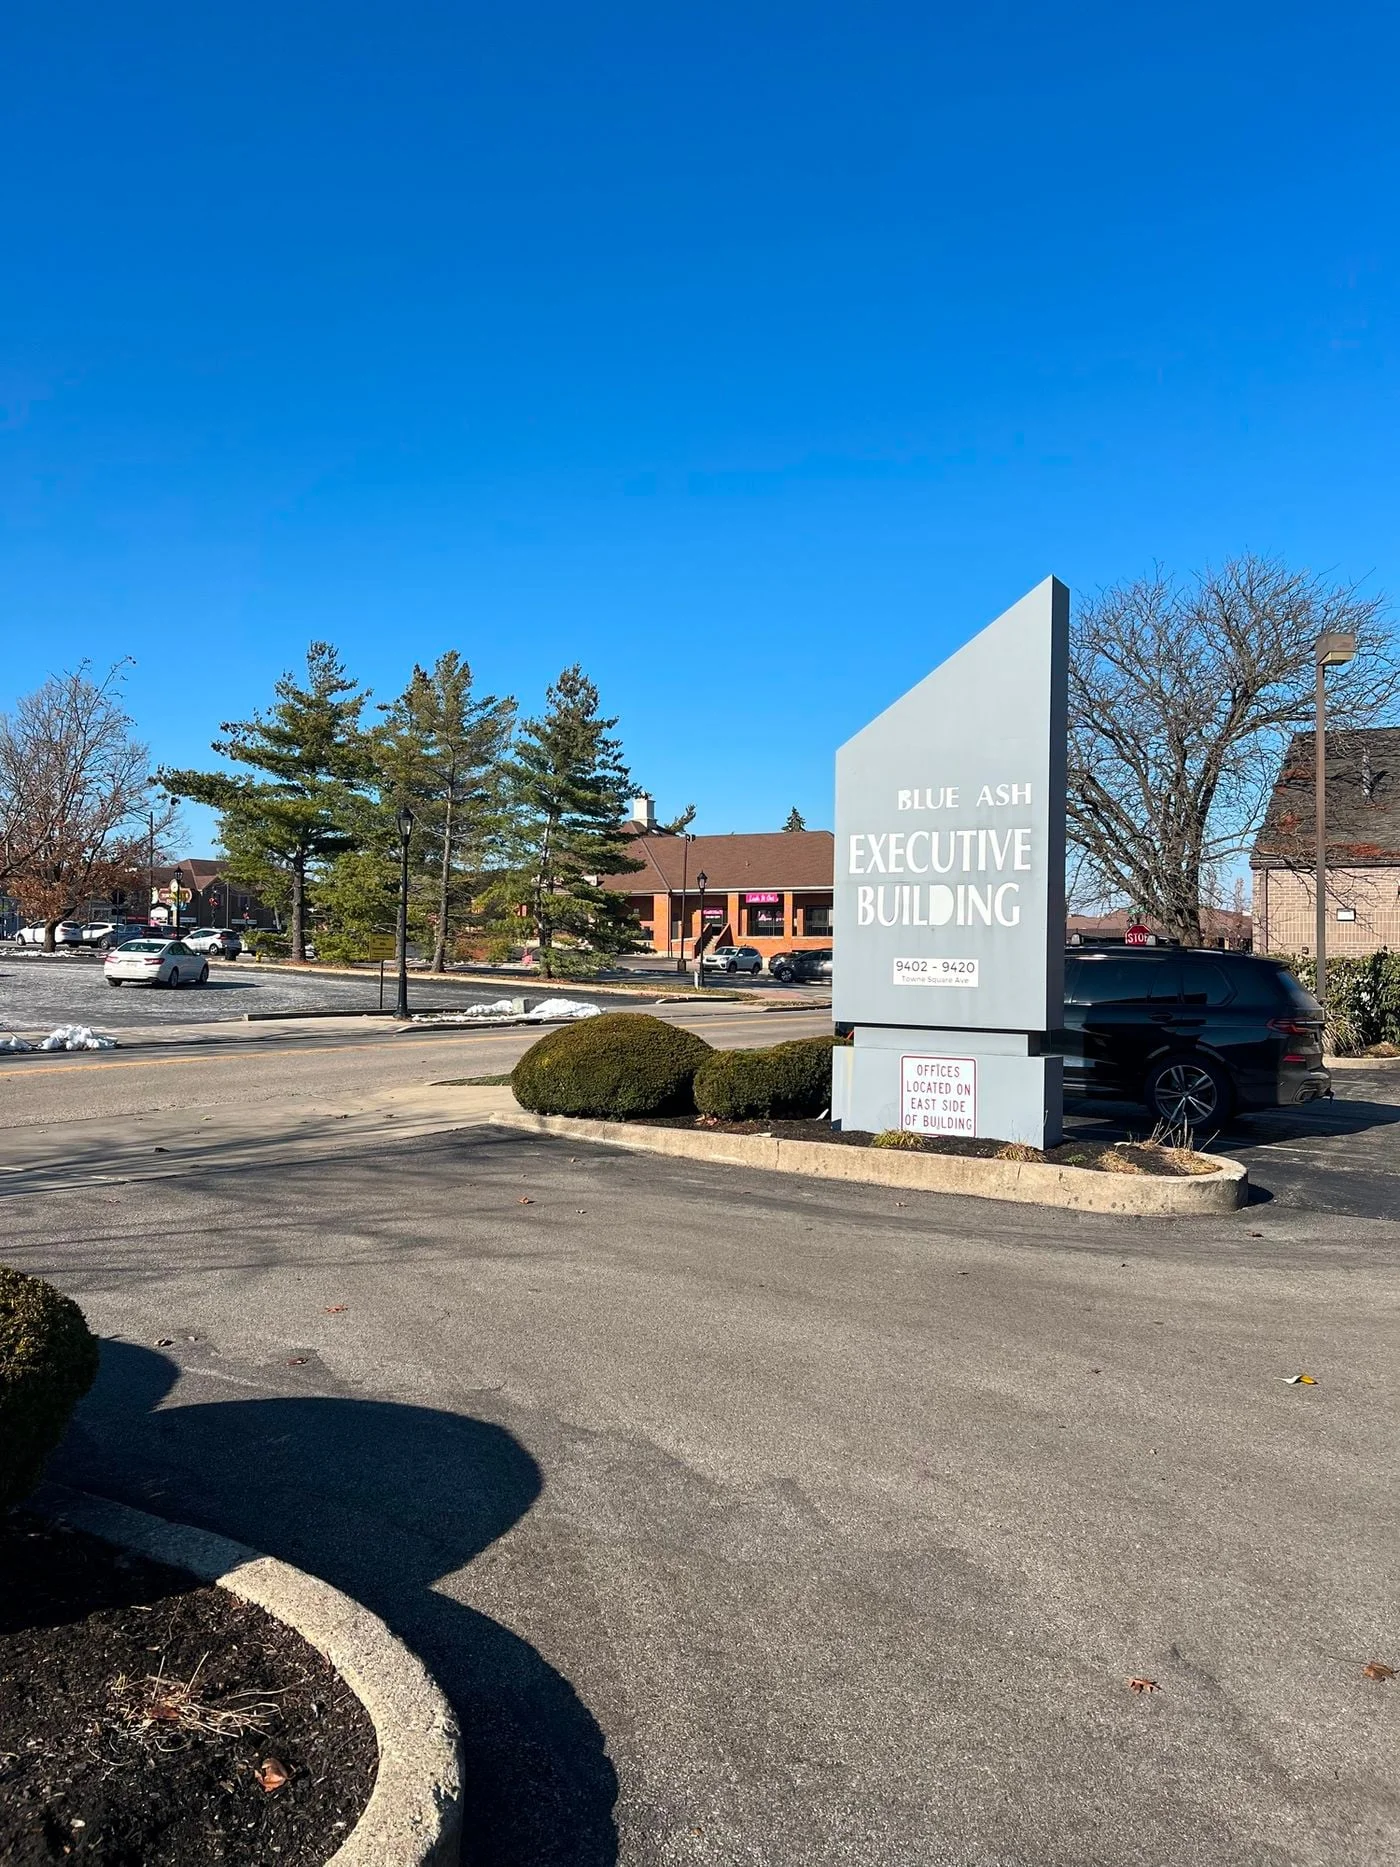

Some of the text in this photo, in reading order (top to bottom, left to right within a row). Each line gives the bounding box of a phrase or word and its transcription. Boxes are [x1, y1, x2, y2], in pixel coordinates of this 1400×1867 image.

[897, 782, 1033, 811] BLUE ASH
[848, 828, 1032, 875] EXECUTIVE
[856, 882, 1021, 927] BUILDING
[896, 960, 928, 972] 9402
[942, 961, 975, 973] 9420
[902, 975, 926, 983] Towne
[927, 976, 953, 984] Square
[916, 1063, 960, 1078] OFFICES
[906, 1080, 971, 1096] LOCATED ON
[911, 1097, 966, 1113] EAST SIDE
[904, 1113, 972, 1130] OF BUILDING
